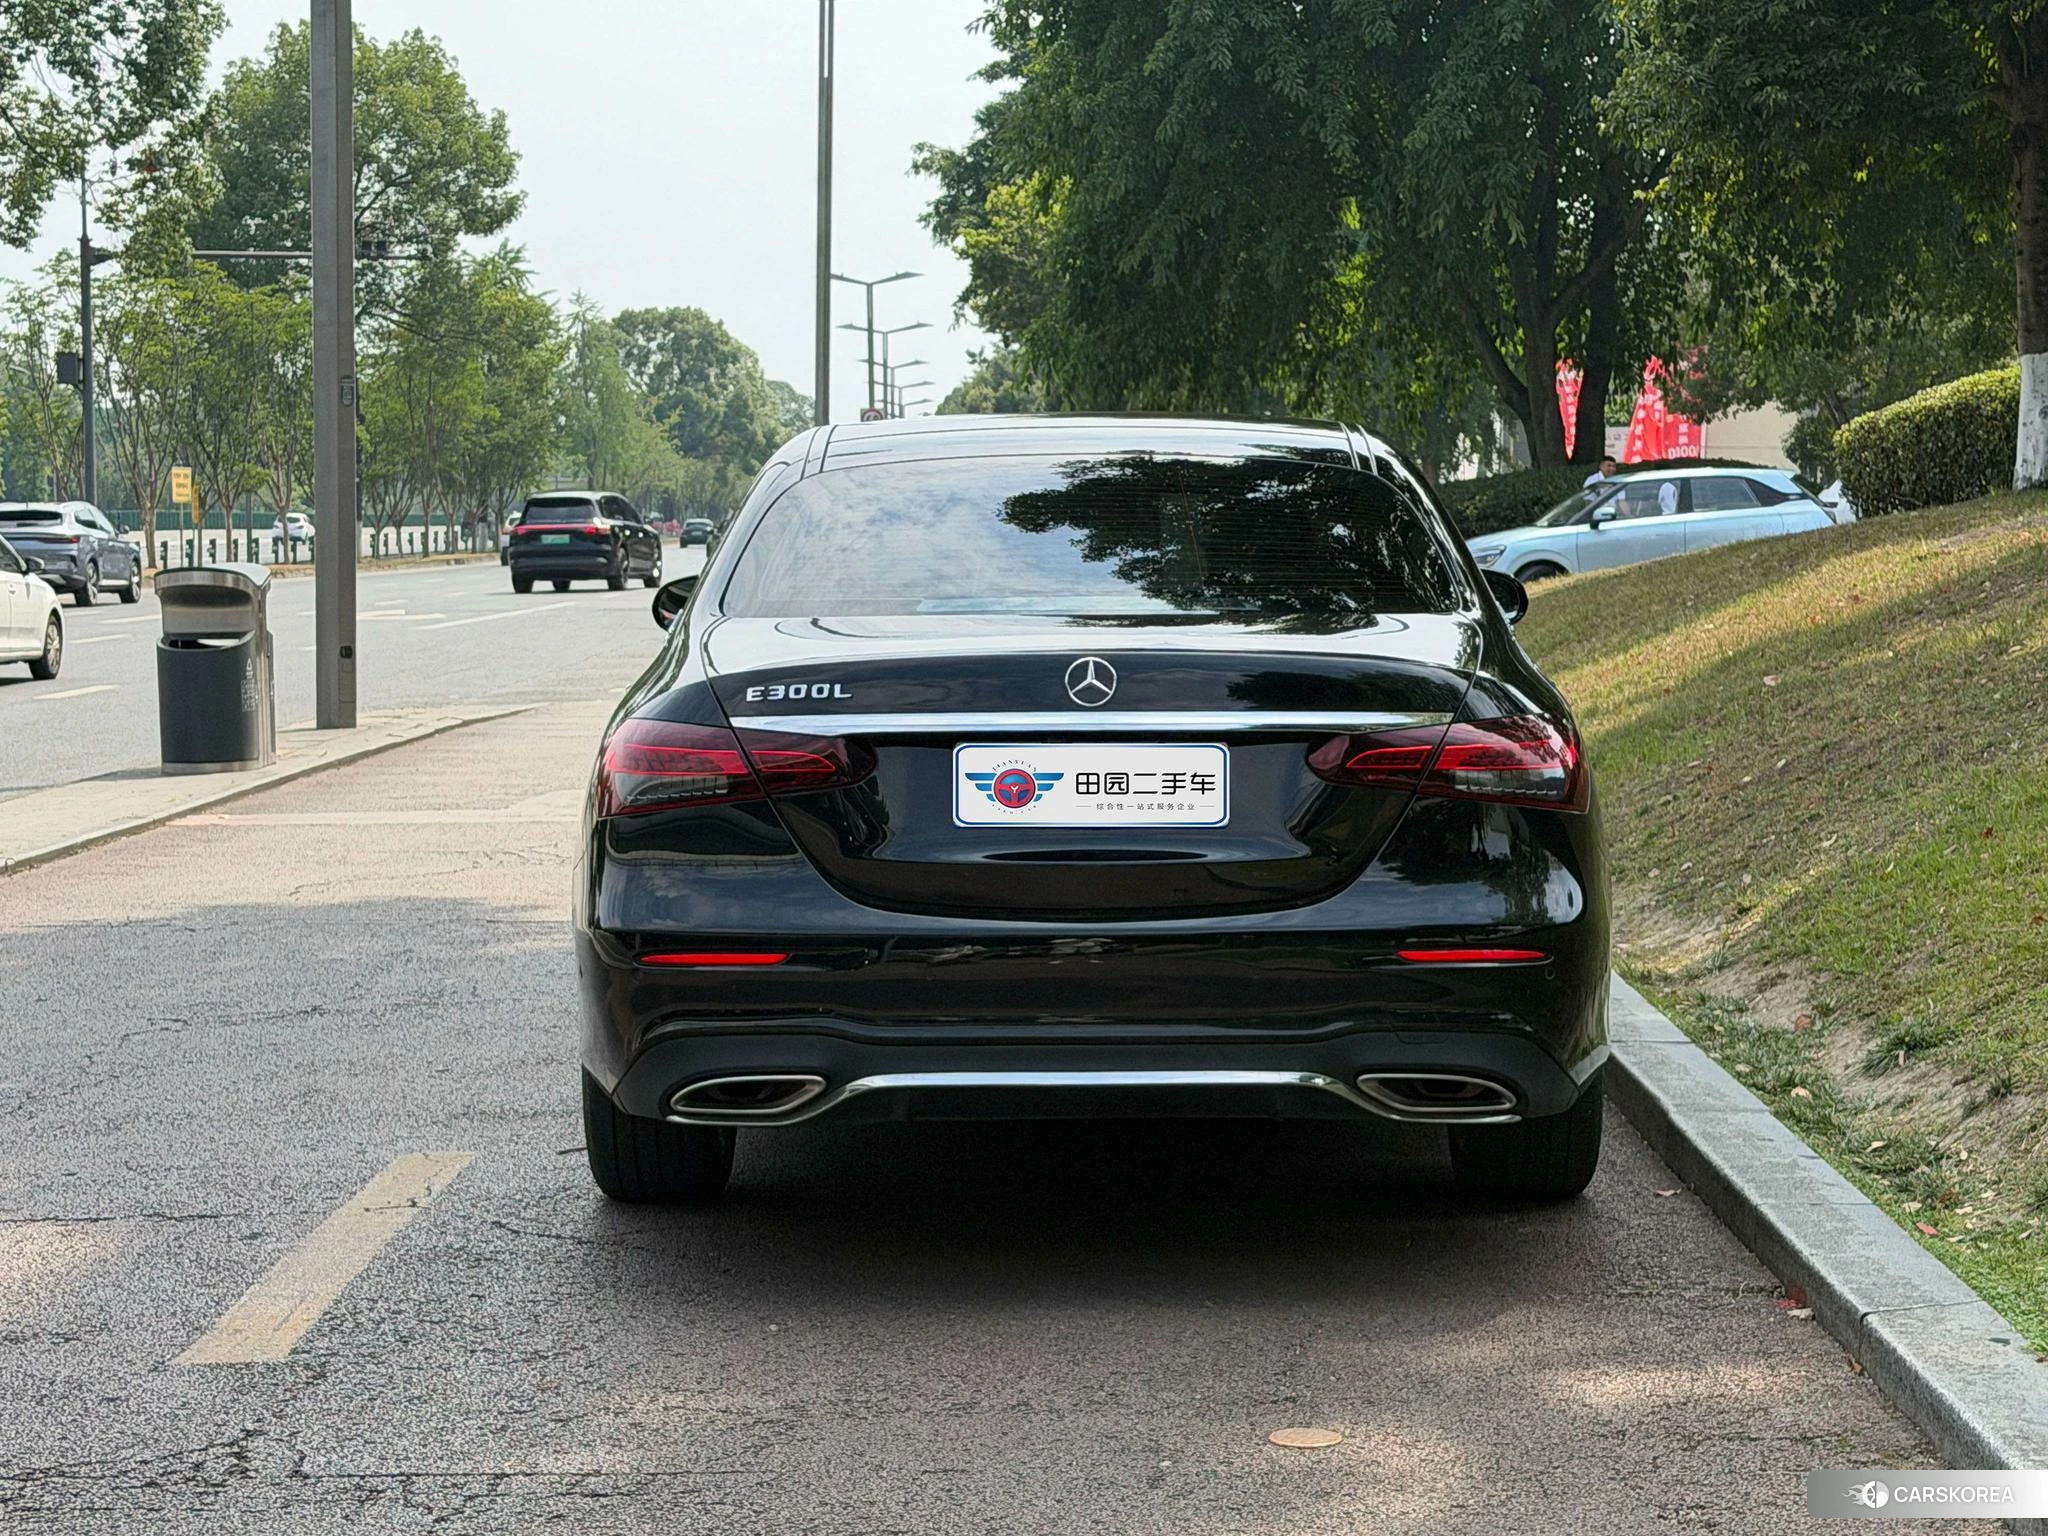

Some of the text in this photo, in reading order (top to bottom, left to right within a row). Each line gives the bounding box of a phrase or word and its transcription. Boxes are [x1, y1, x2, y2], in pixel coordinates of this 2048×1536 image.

[746, 683, 852, 702] E300L
[1076, 772, 1216, 795] 田园二手车
[1096, 803, 1195, 811] 综合性一站式服务企业
